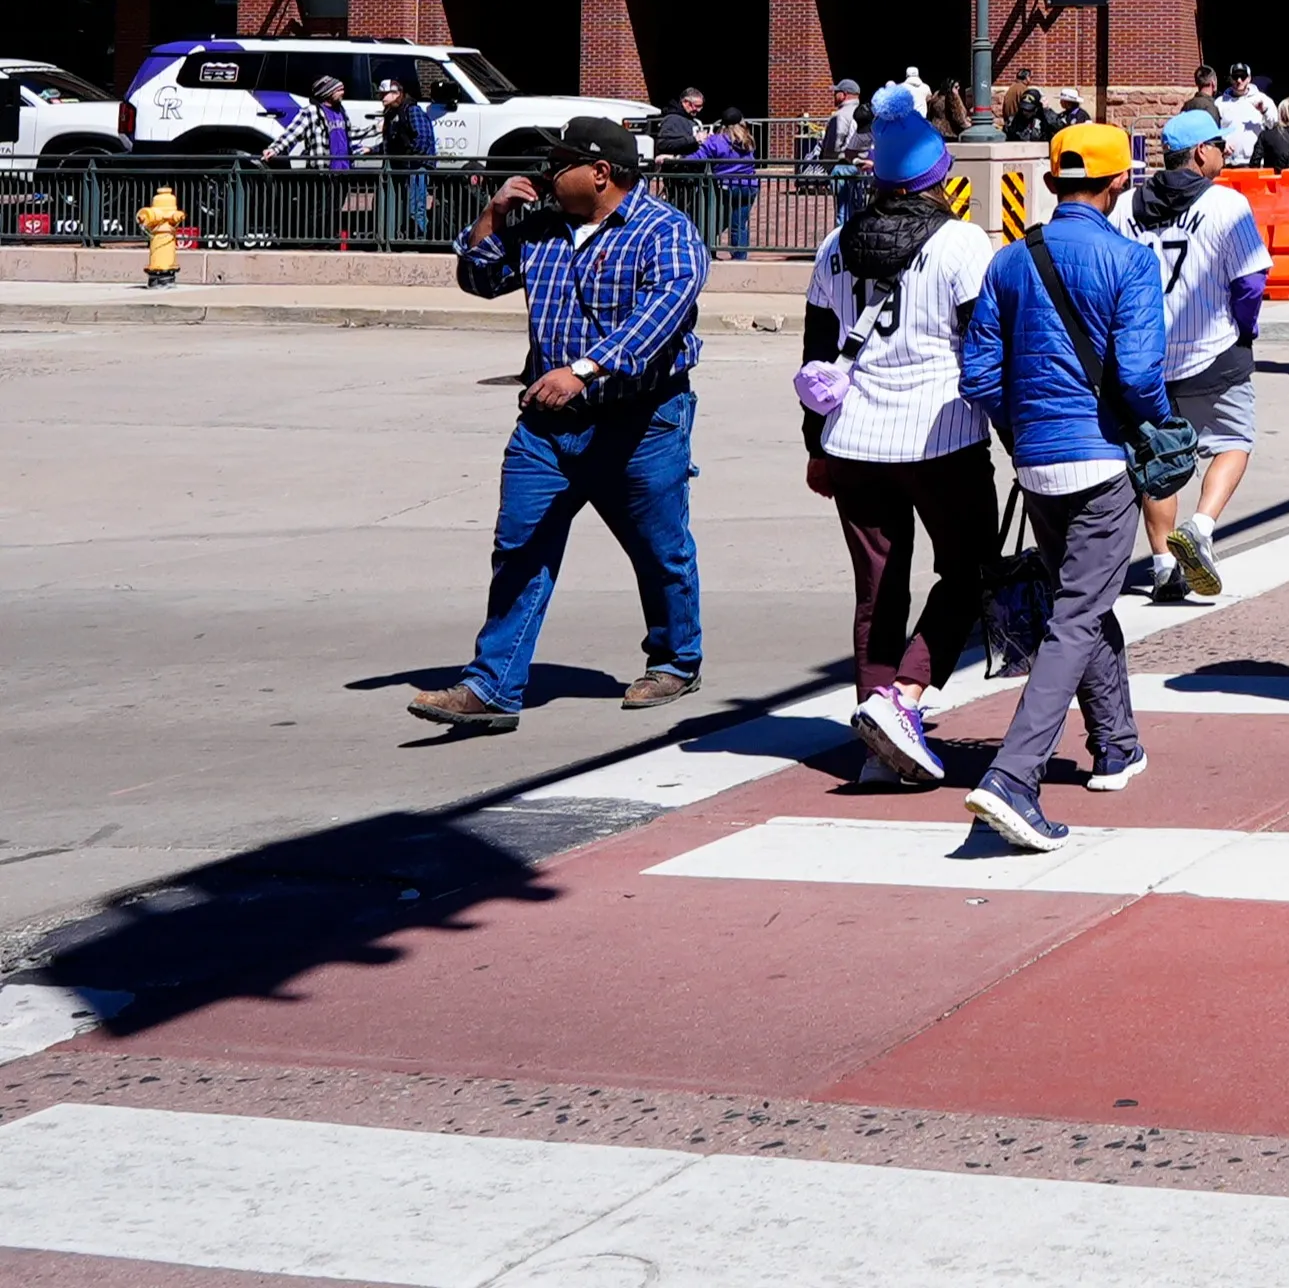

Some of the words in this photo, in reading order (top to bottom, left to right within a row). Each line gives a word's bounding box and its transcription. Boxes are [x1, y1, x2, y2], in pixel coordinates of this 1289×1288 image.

[153, 86, 183, 120] CR
[431, 119, 467, 128] OYOTA
[56, 219, 123, 233] TOTA
[204, 233, 279, 249] TOOTA
[1148, 240, 1188, 295] 7
